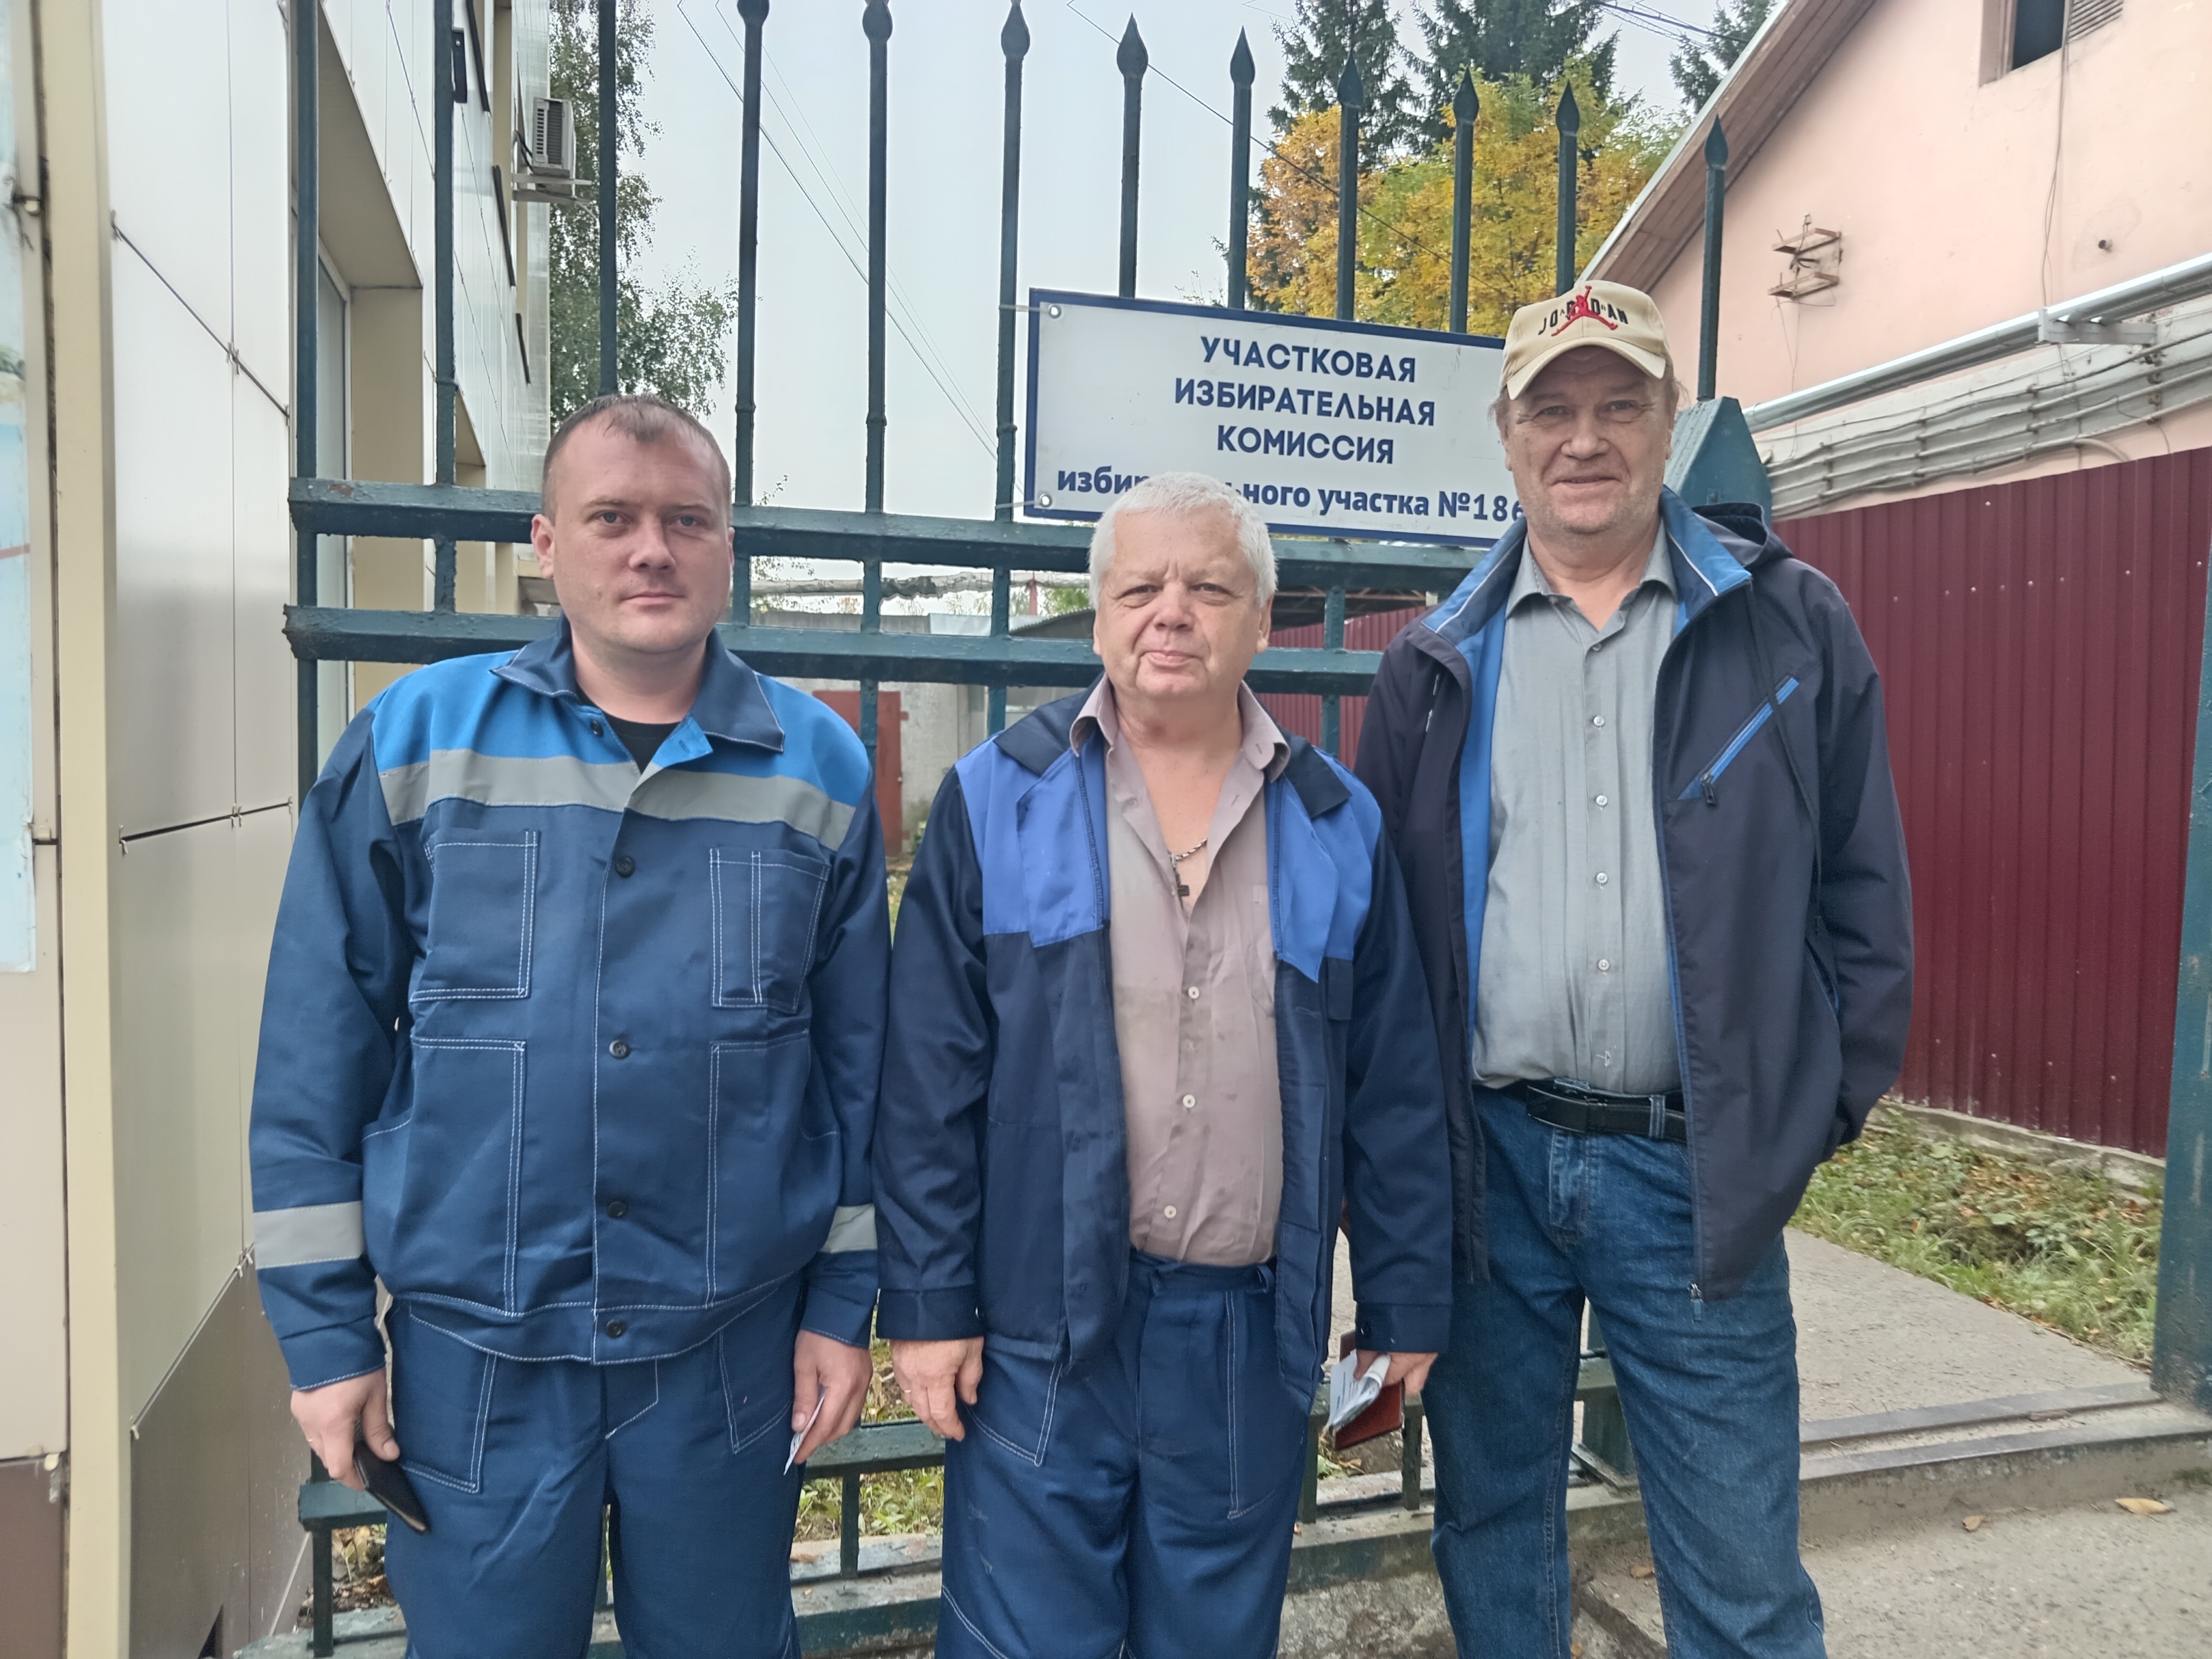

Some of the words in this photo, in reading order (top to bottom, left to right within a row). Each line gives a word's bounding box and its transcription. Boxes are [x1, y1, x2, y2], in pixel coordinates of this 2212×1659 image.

[1202, 336, 1415, 382] УЧАСТКОВАЯ
[1175, 377, 1435, 426] ИЗБИРАТЕЛЬНАЯ
[1217, 424, 1394, 464] КОМИССИЯ
[1057, 465, 1311, 508] избиного
[1318, 489, 1429, 516] участка
